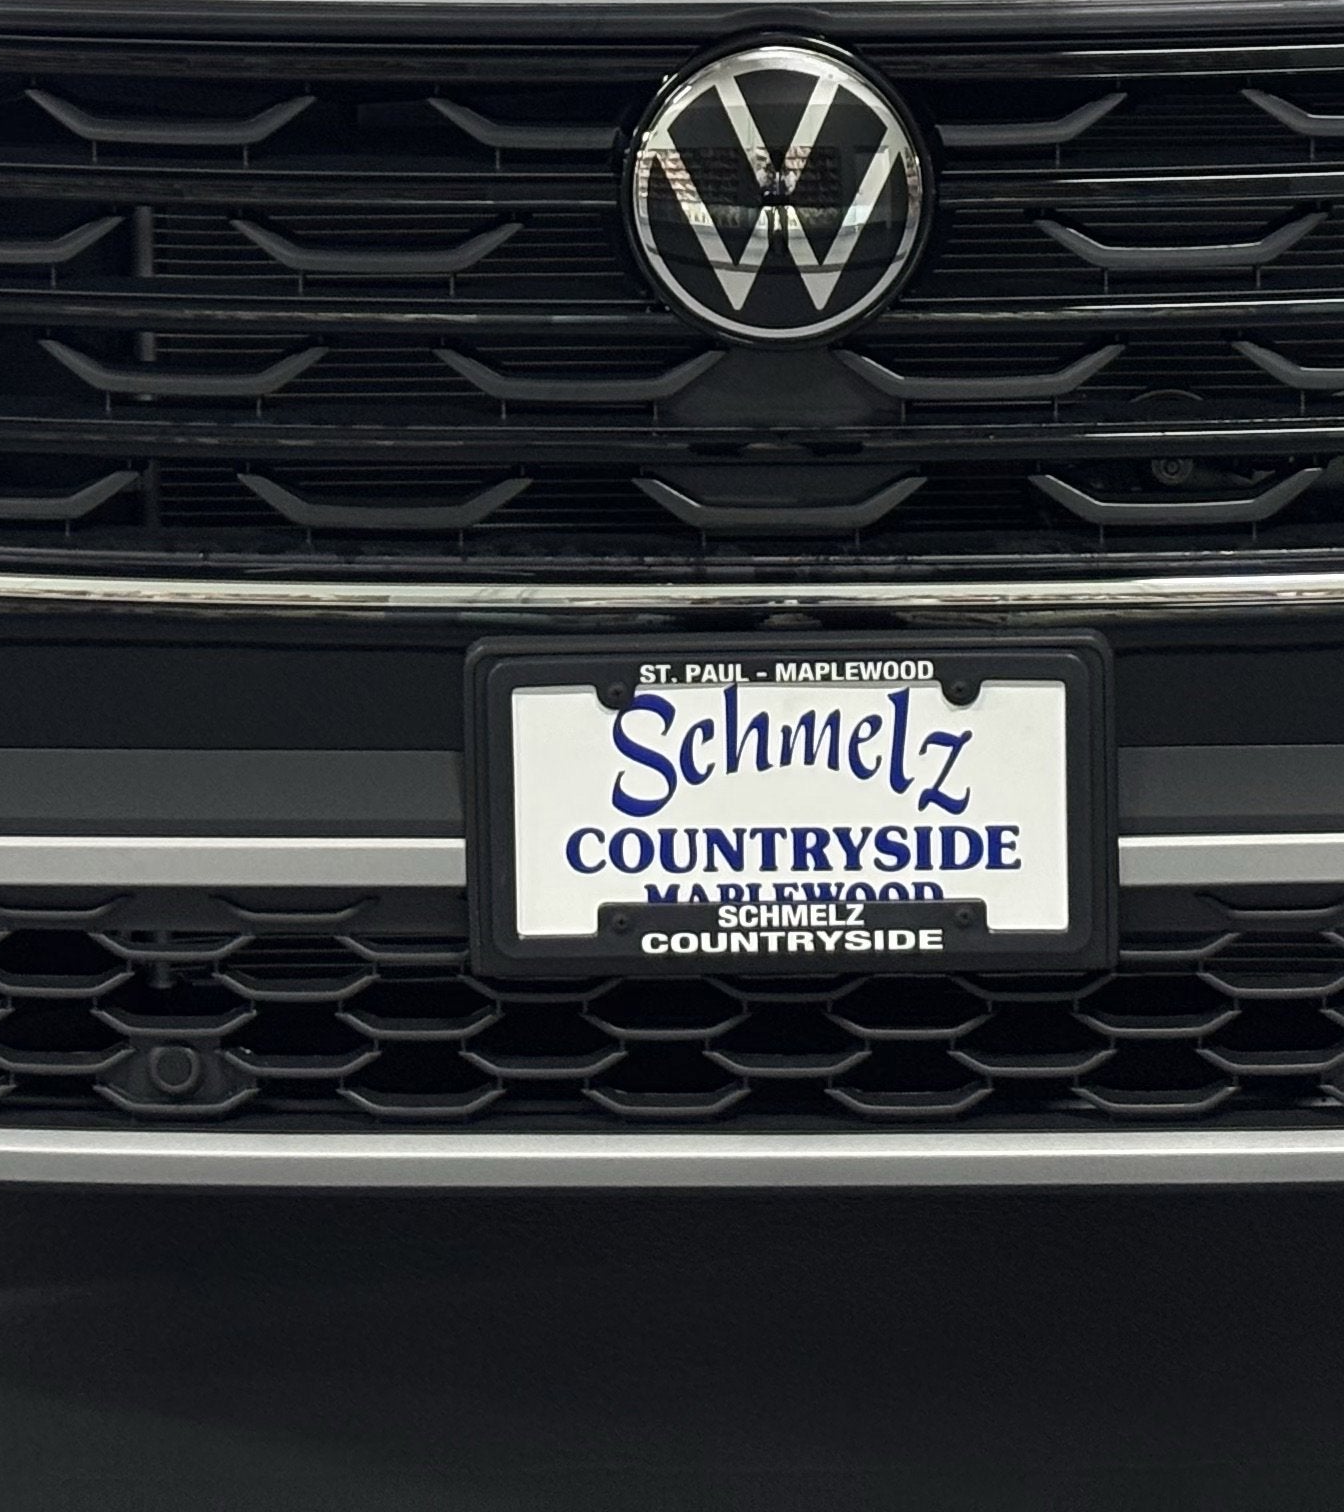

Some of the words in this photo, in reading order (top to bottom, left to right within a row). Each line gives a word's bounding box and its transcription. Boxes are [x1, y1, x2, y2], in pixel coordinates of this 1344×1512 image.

[639, 664, 678, 683] ST.
[685, 663, 750, 683] PAUL
[775, 660, 935, 682] MAPLEWOOD
[612, 684, 973, 818] Schmelz
[565, 825, 1022, 875] COUNTRYSIDE
[717, 903, 865, 928] SCHMELZ
[641, 929, 944, 954] COUNTRYSIDE
